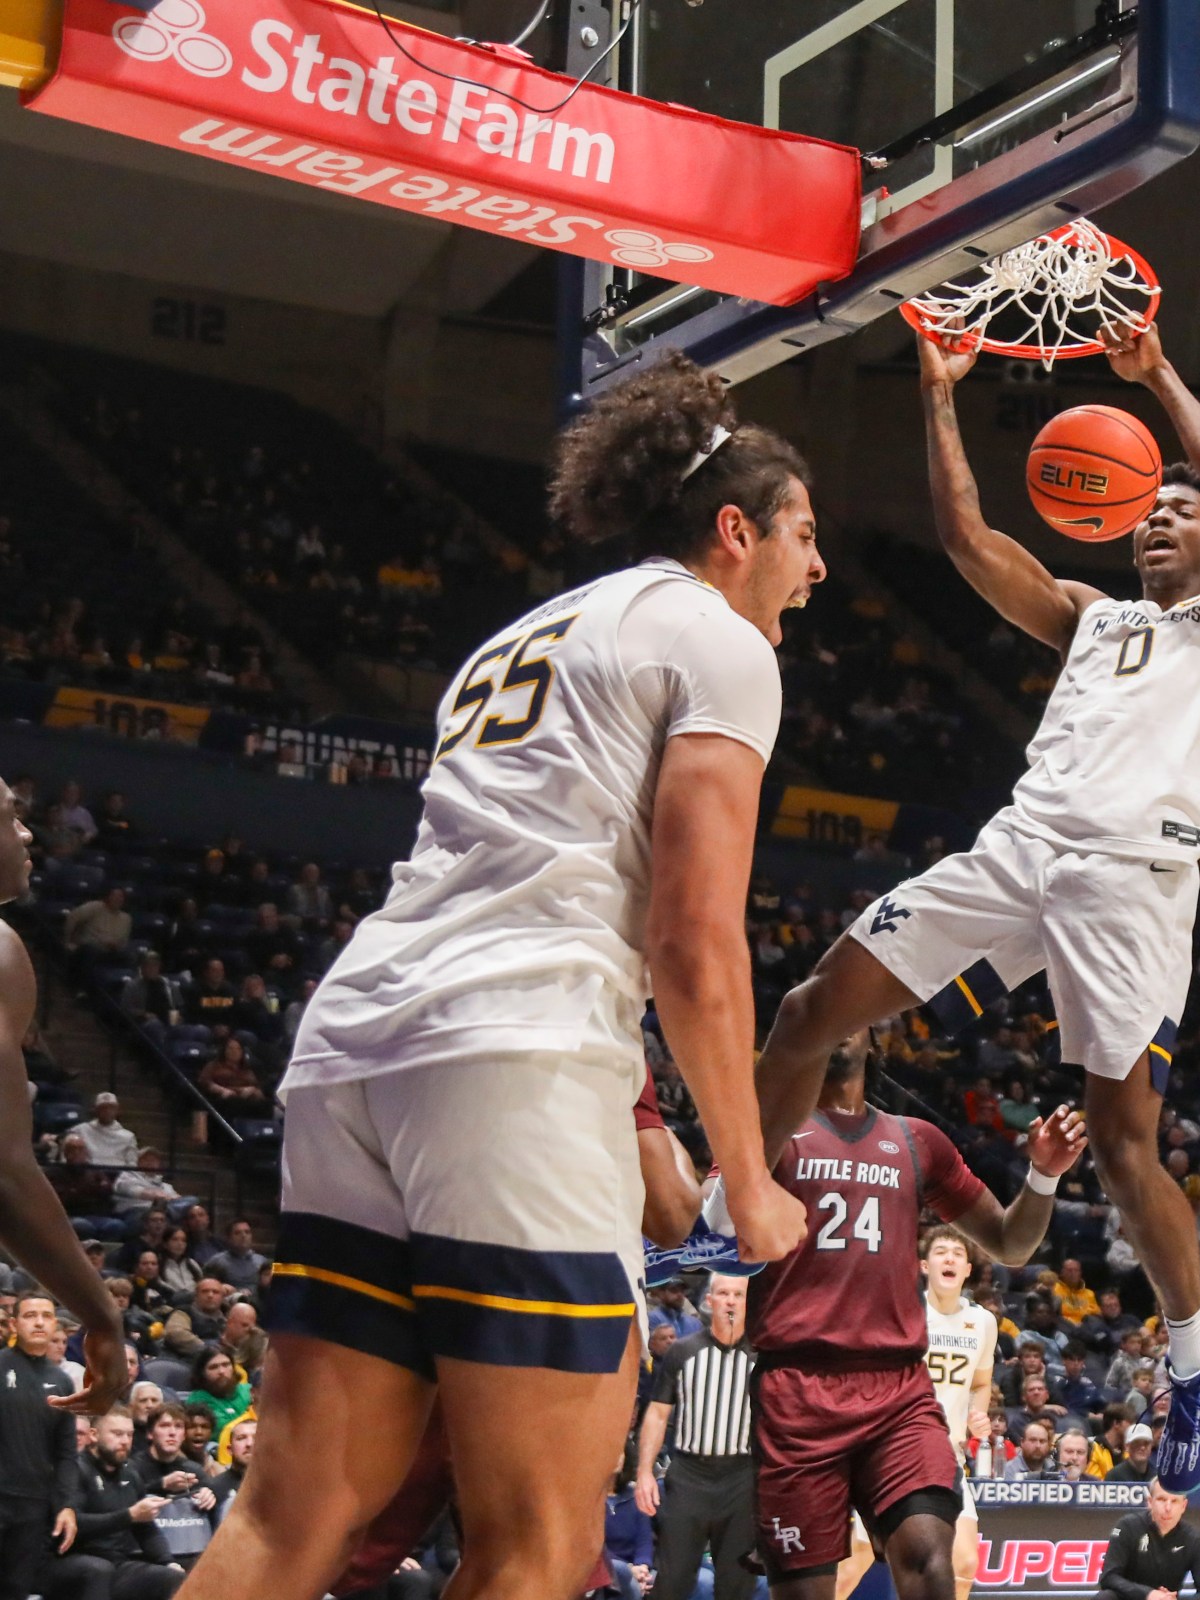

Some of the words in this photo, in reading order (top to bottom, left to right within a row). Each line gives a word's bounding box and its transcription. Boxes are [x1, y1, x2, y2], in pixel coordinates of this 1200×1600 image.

[1041, 462, 1108, 496] ELITE
[1113, 624, 1156, 678] 0
[432, 611, 583, 765] 55
[796, 1157, 853, 1180] LITTLE
[856, 1162, 900, 1188] ROCK
[817, 1192, 882, 1252] 24
[928, 1333, 978, 1350] OUNTAINEERS
[928, 1351, 970, 1386] 52
[969, 1481, 1073, 1503] VERSIFIED
